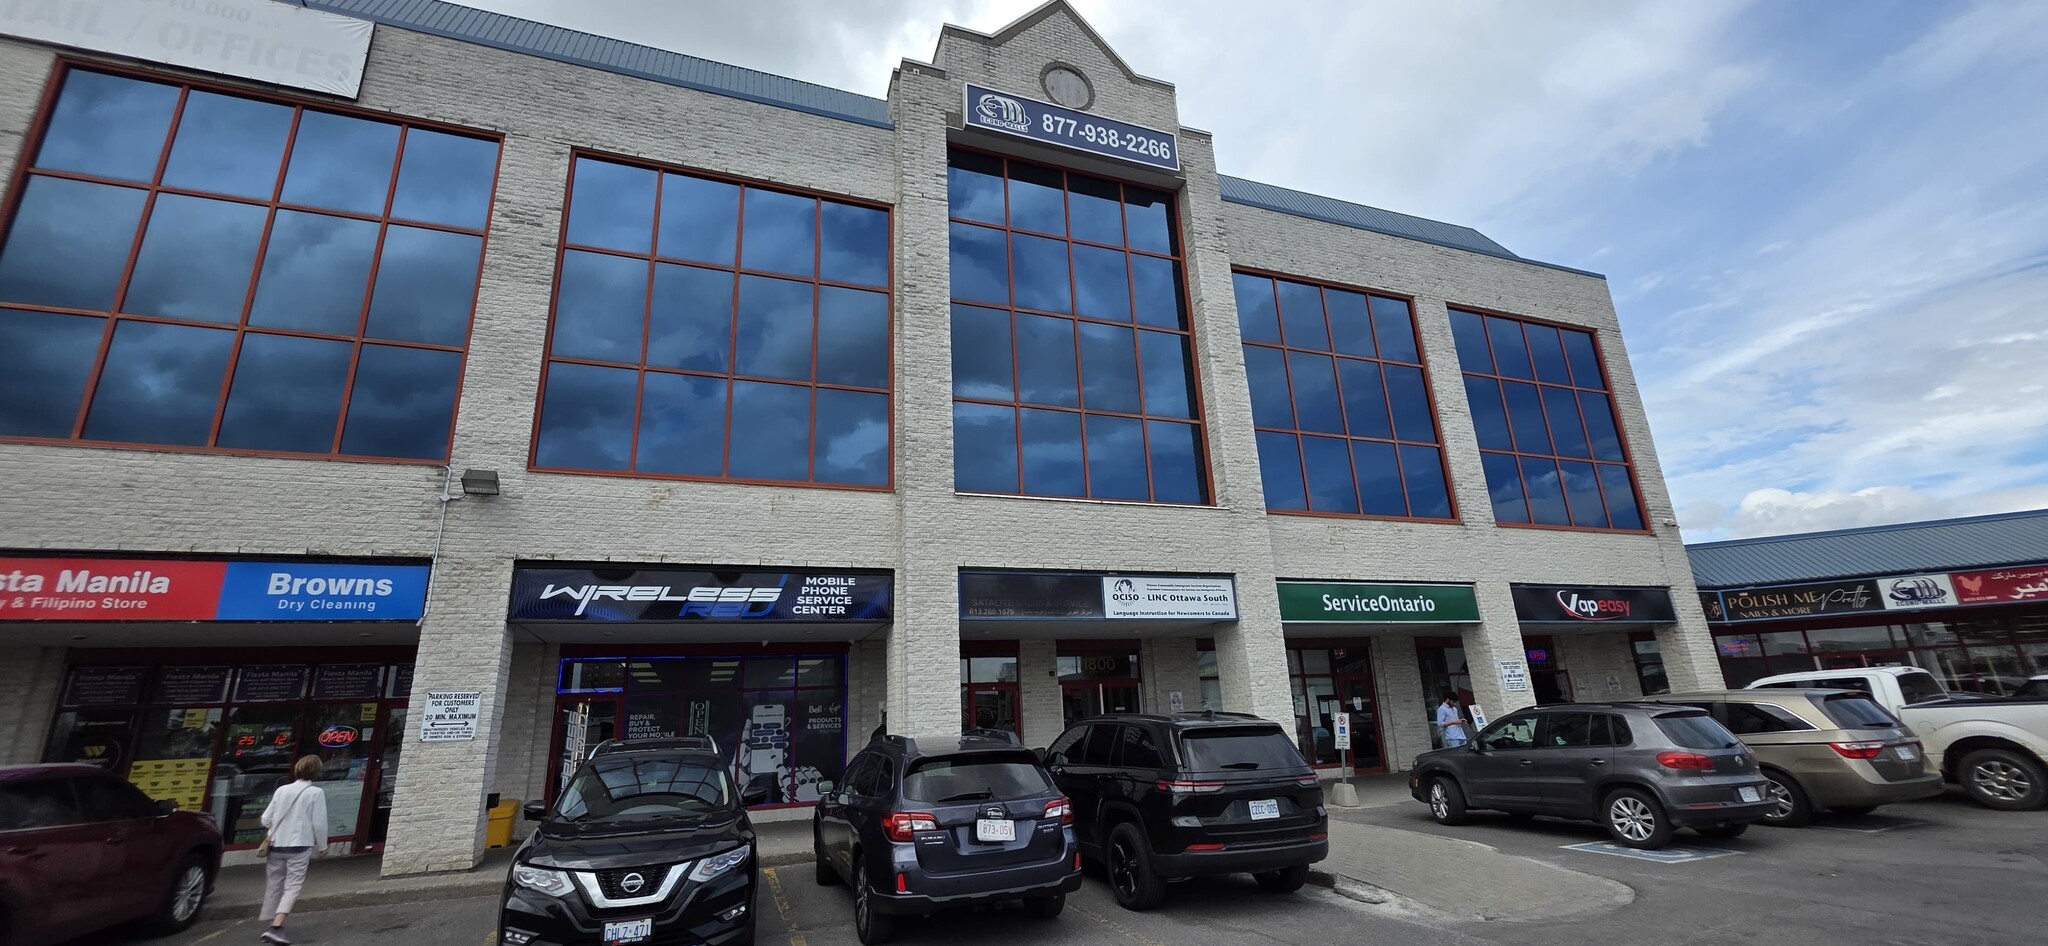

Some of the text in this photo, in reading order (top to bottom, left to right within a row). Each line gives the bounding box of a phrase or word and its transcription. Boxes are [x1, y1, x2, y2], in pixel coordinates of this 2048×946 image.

[157, 21, 352, 82] OFFICES
[1042, 113, 1171, 160] 877-938-2266
[55, 570, 170, 593] Manila
[267, 572, 393, 596] Browns
[805, 577, 856, 586] MOBILE
[801, 587, 848, 595] PHONE
[1112, 593, 1139, 601] OCISO
[1147, 594, 1167, 602] LINC
[1169, 594, 1202, 602] Ottawa
[1203, 594, 1229, 602] South
[11, 597, 26, 608] &
[30, 596, 96, 610] Filipino
[101, 597, 148, 609] Store
[278, 599, 376, 612] Dry Cleaning
[796, 596, 852, 605] SERVICE
[1322, 594, 1435, 612] ServiceOntario
[1728, 594, 1788, 609] POLISH
[1794, 592, 1820, 604] ME
[792, 605, 846, 614] CENTER
[1740, 610, 1769, 619] NAILS
[1783, 607, 1813, 615] MORE
[1084, 656, 1116, 670] 1800
[809, 705, 822, 714] Bell
[693, 702, 705, 735] OPEN
[238, 735, 288, 746] 25 12
[320, 730, 355, 743] OPEN
[983, 823, 996, 835] 873
[606, 924, 649, 941] CHLZ 471
